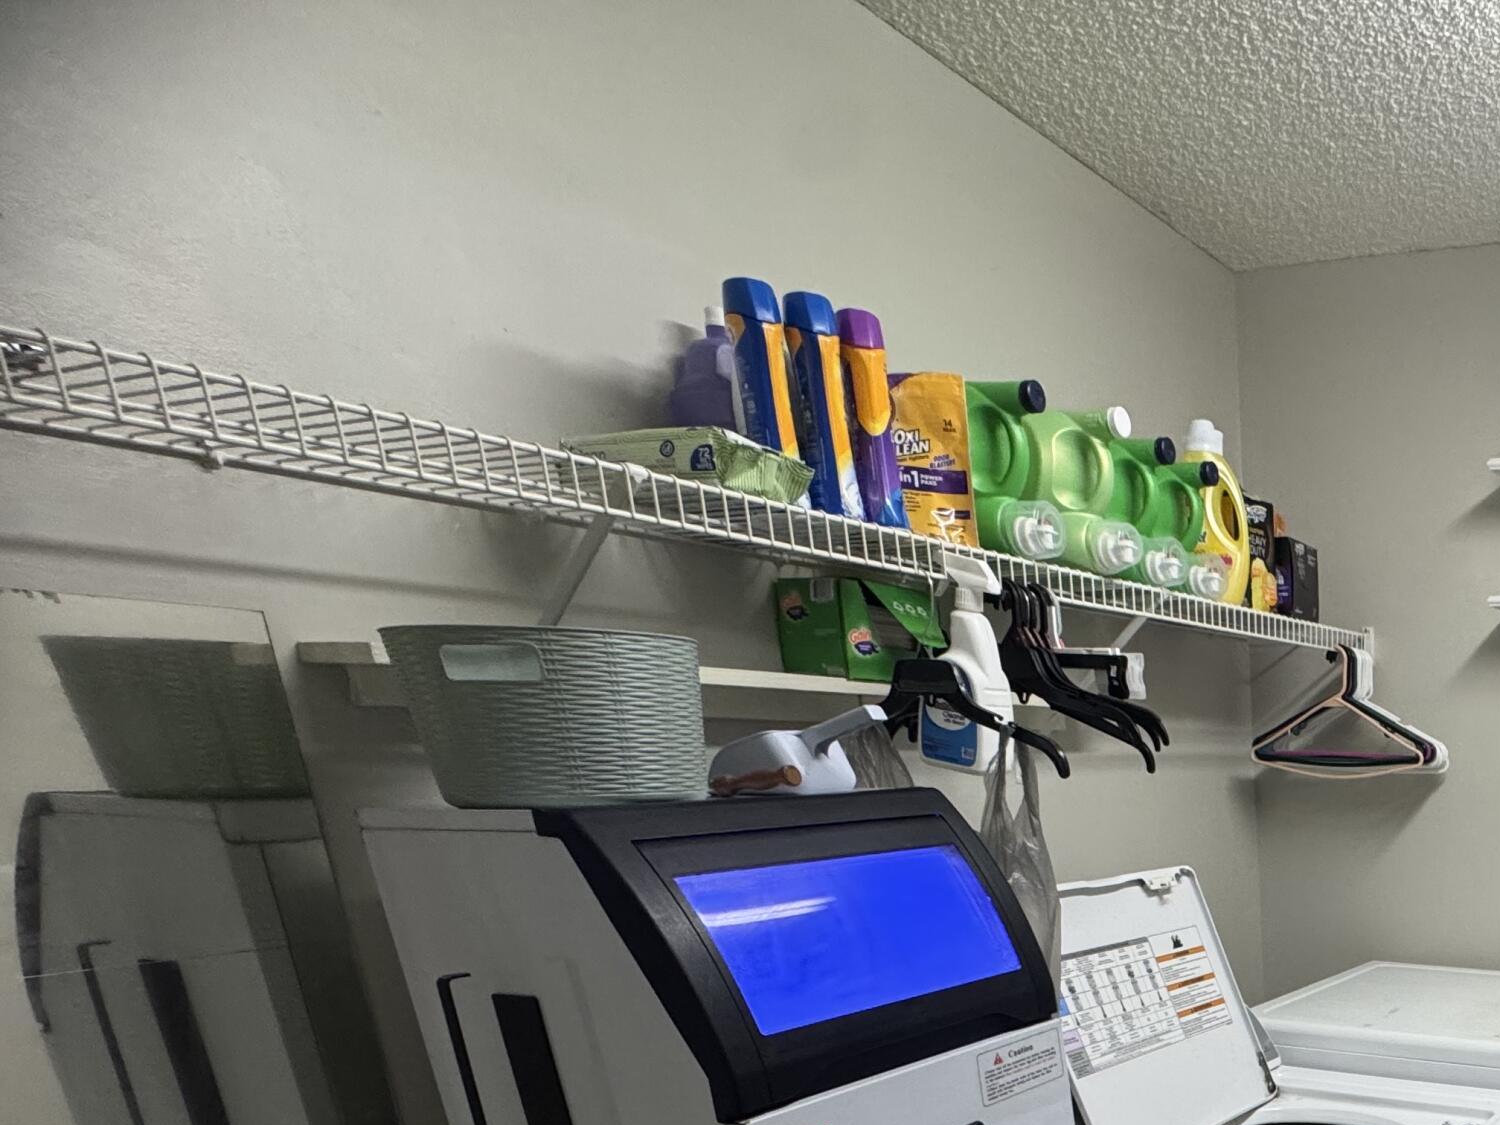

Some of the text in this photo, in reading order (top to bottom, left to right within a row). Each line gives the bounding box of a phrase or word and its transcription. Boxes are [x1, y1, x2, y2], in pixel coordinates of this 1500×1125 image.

[894, 430, 919, 444] OXI
[698, 447, 709, 456] 72
[896, 441, 929, 456] LEAN
